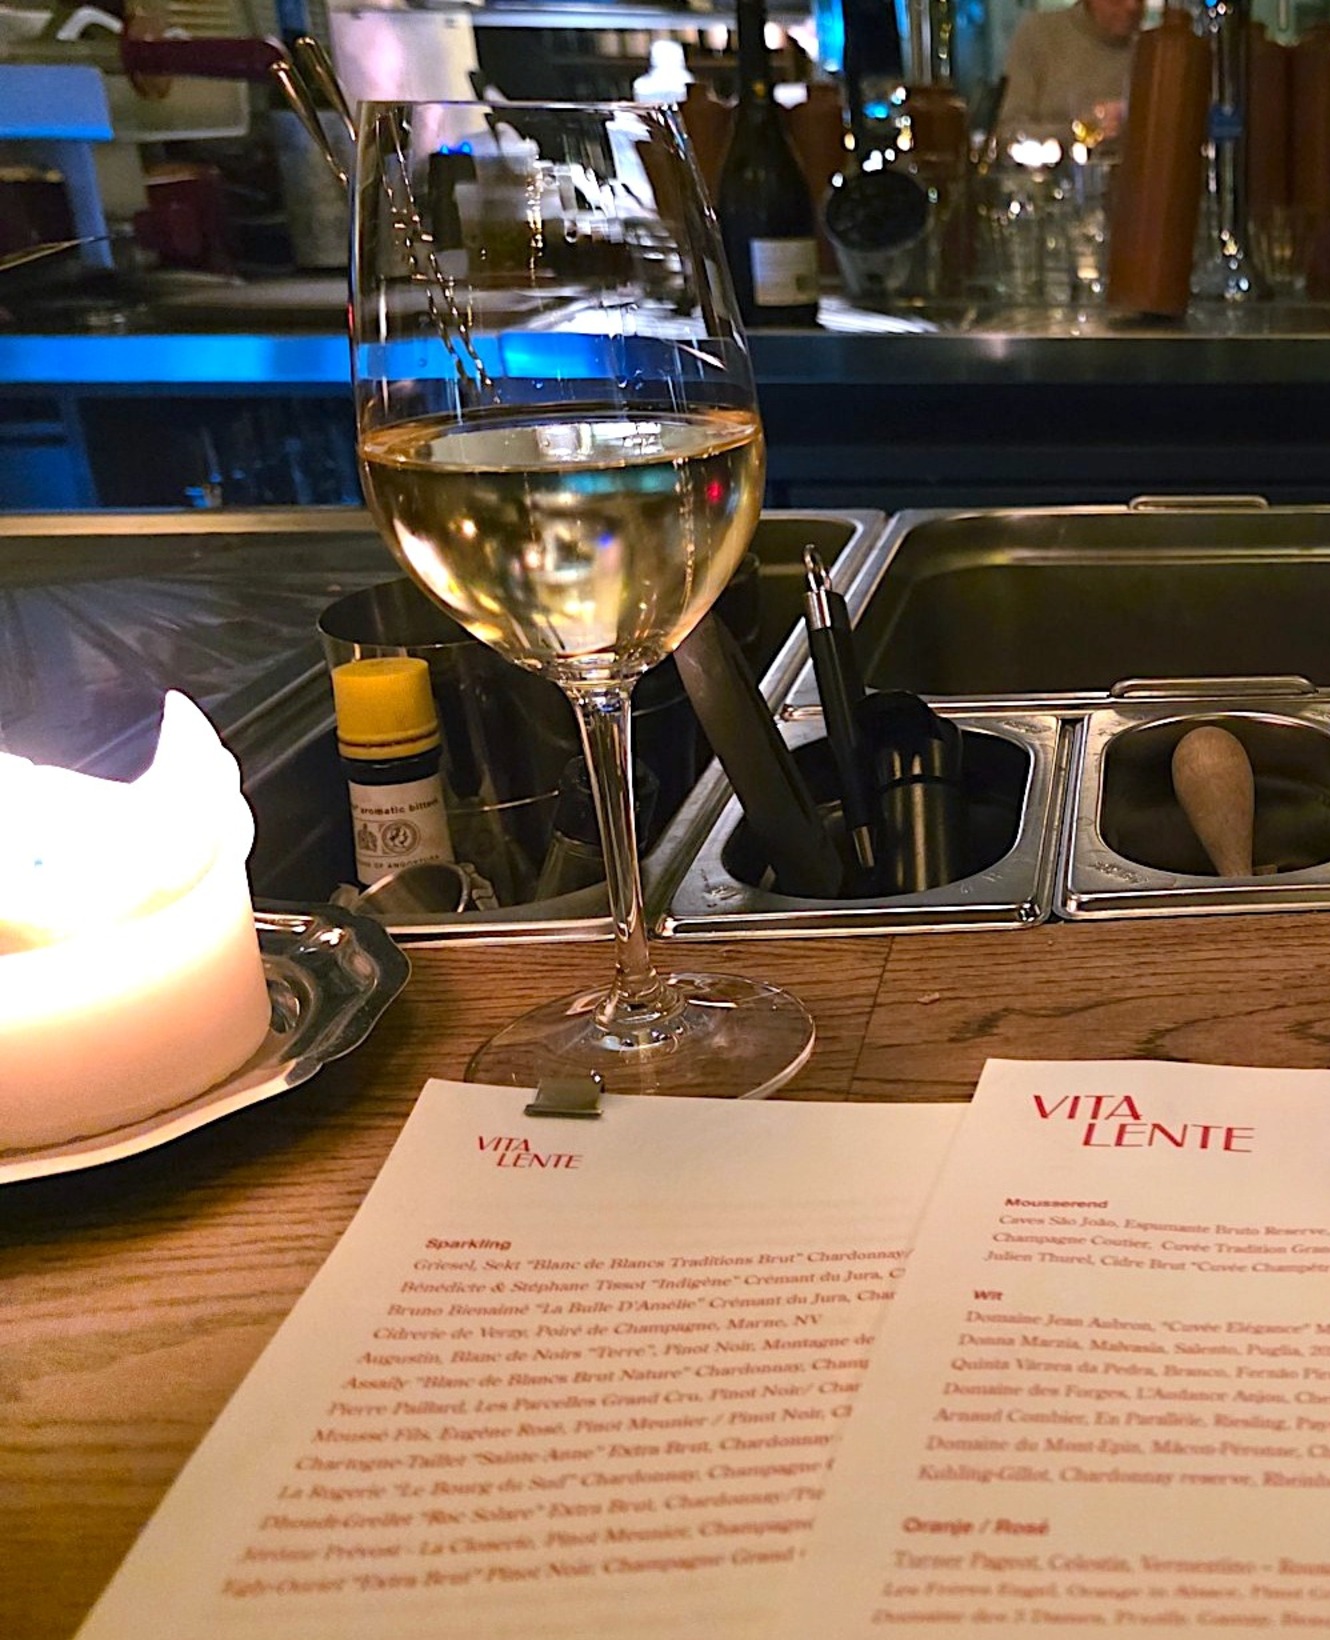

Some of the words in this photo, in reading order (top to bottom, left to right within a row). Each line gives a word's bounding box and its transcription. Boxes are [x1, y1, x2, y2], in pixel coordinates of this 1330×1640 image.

[1033, 1094, 1142, 1120] VITA
[478, 1135, 530, 1152] VITA
[1082, 1123, 1255, 1152] LENTE
[496, 1153, 583, 1169] LENTE
[1004, 1198, 1108, 1210] Mousserend
[425, 1238, 512, 1250] Sparkling
